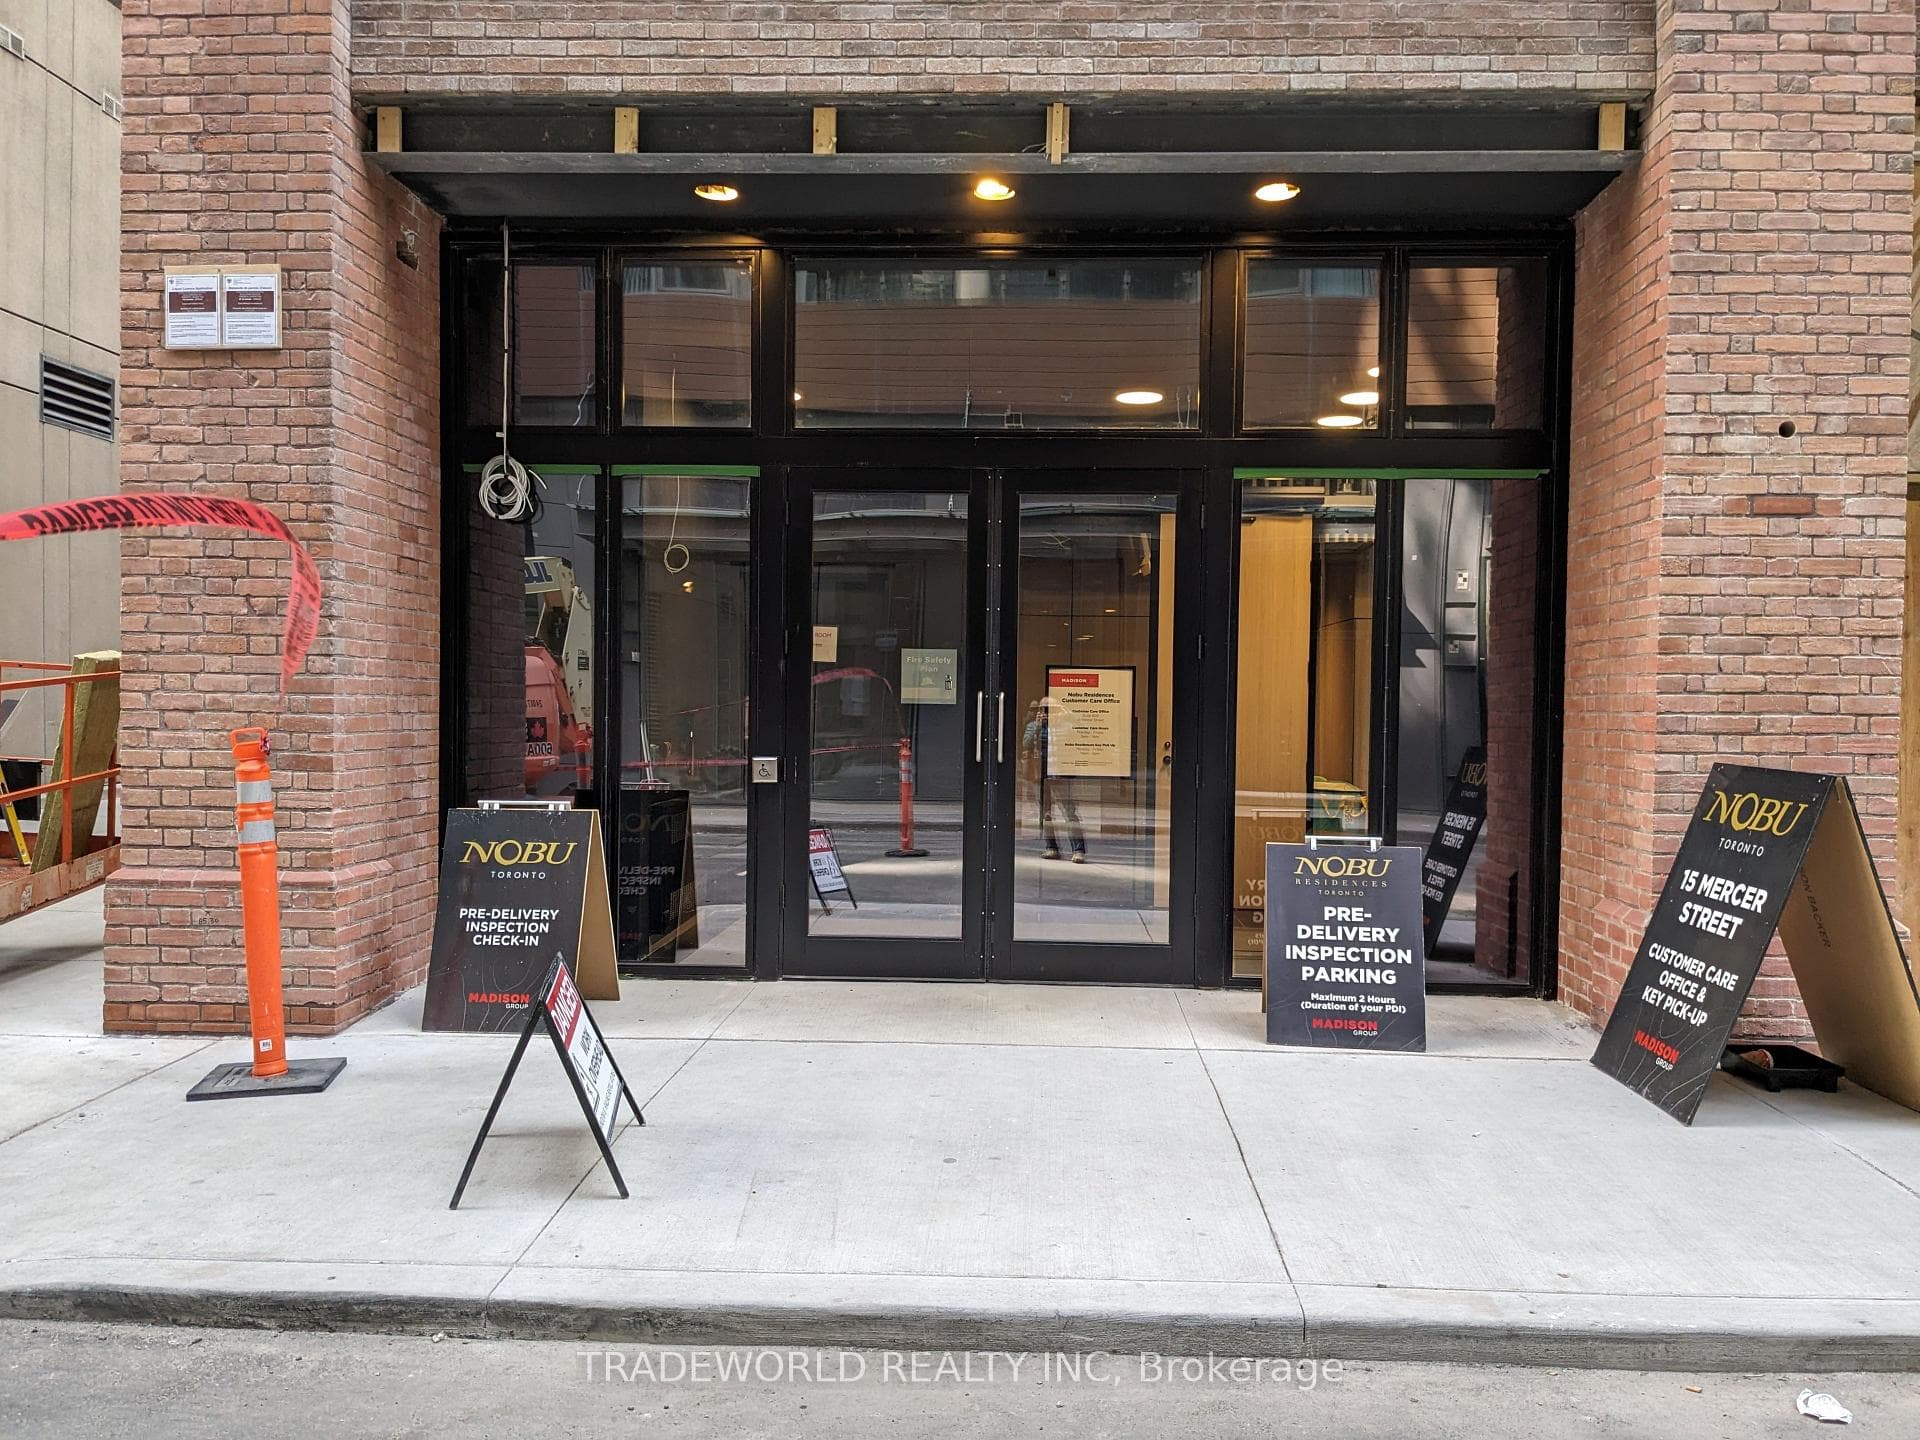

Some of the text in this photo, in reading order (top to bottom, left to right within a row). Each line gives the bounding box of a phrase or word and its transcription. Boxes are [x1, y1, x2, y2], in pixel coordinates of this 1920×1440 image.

[1703, 790, 1808, 836] NOBU
[459, 839, 577, 866] NOBU
[1719, 837, 1764, 857] TORONTO
[490, 870, 546, 880] TORONTO
[1294, 856, 1392, 877] NOBU
[1295, 878, 1388, 888] RESIDENCES
[1680, 869, 1768, 914] 15 MERCER
[1318, 889, 1364, 897] TORONTO
[459, 907, 559, 921] PRE-DELIVERY
[1323, 906, 1372, 922] PRE-
[1678, 901, 1743, 940] STREET
[465, 921, 550, 934] INSPECTION
[1297, 925, 1400, 943] DELIVERY
[472, 934, 539, 947] CHECK-IN
[1285, 945, 1412, 965] INSPECTION
[1301, 966, 1397, 985] PARKING
[1649, 942, 1739, 992] CUSTOMER CARE
[1659, 970, 1707, 1003] OFFICE &
[468, 992, 530, 1004] MADISON
[1310, 992, 1396, 1004] Maximum 2 Hours
[1642, 985, 1708, 1028] KEY PICK-UP
[550, 974, 581, 1042] DANGER
[1300, 1001, 1406, 1014] (Duration of your PDI)
[1312, 1018, 1378, 1031] MADISON
[1634, 1029, 1680, 1064] MADISON
[1655, 1056, 1674, 1071] GROUP
